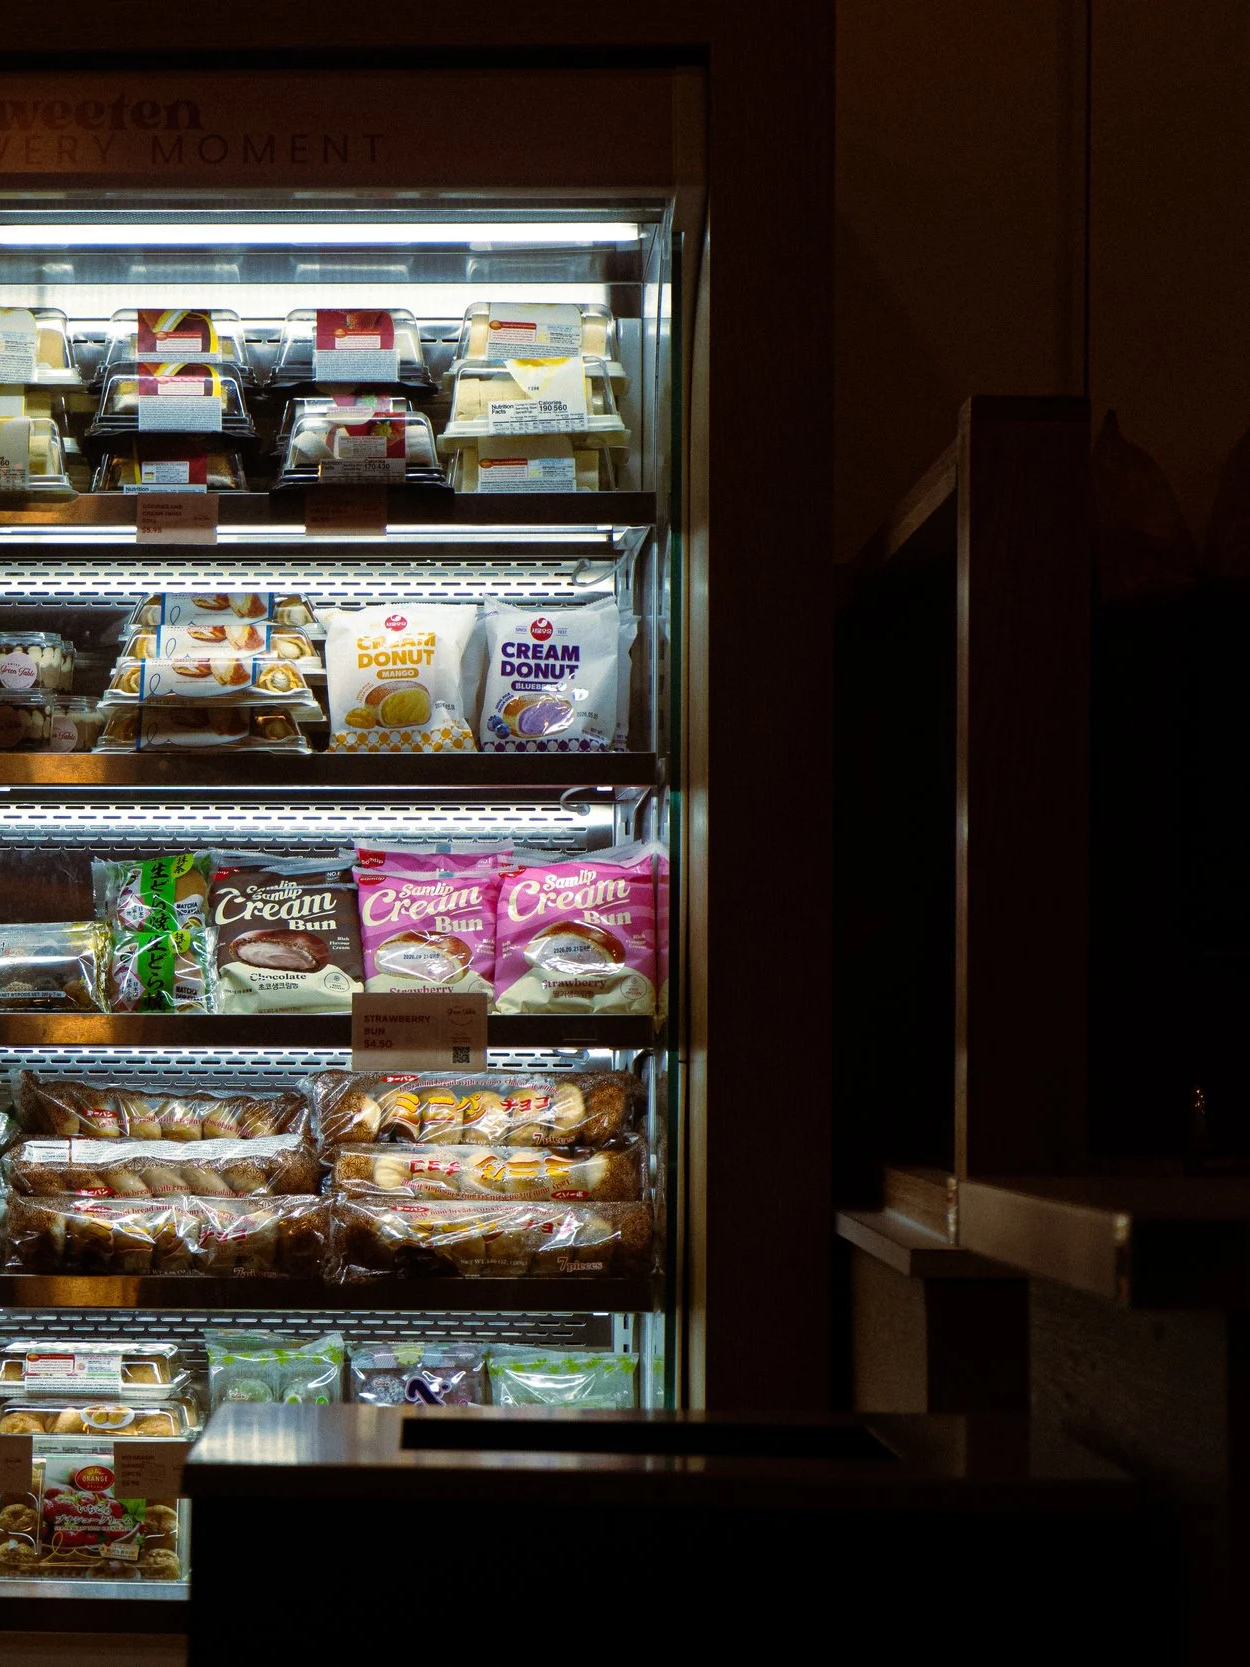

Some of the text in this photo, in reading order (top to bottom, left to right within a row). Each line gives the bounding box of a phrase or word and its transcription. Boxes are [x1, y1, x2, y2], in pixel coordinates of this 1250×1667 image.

[152, 133, 384, 164] MOMENT
[539, 404, 553, 412] 190
[501, 641, 580, 662] CREAM
[357, 650, 435, 669] DONUT
[0, 665, 35, 677] Green Table
[382, 669, 415, 678] MANGO
[500, 660, 579, 680] DONUT
[173, 854, 187, 874] 抹茶
[543, 869, 597, 891] Samlip
[252, 888, 303, 901] Samlip
[399, 882, 454, 899] Samlip
[215, 887, 337, 926] Cream
[362, 886, 482, 927] Cream
[508, 878, 631, 922] Cream
[434, 915, 483, 933] Bun
[582, 910, 632, 926] Bun
[287, 919, 338, 931] Bun
[250, 973, 307, 981] Chocolate
[175, 986, 198, 995] MATCHA
[542, 978, 607, 990] Strawberry
[364, 1015, 431, 1023] STRAWBERRY
[364, 1027, 385, 1035] BUN
[364, 1039, 393, 1048] $4.50
[392, 1092, 551, 1127] ミニパン チョコ
[409, 1155, 574, 1182] チョコ ミニパン
[131, 1188, 155, 1197] bread
[155, 1186, 172, 1194] with
[172, 1185, 200, 1193] creamy
[130, 1206, 155, 1216] bread
[82, 1475, 109, 1483] ORANGE
[76, 1502, 112, 1514] いちごの
